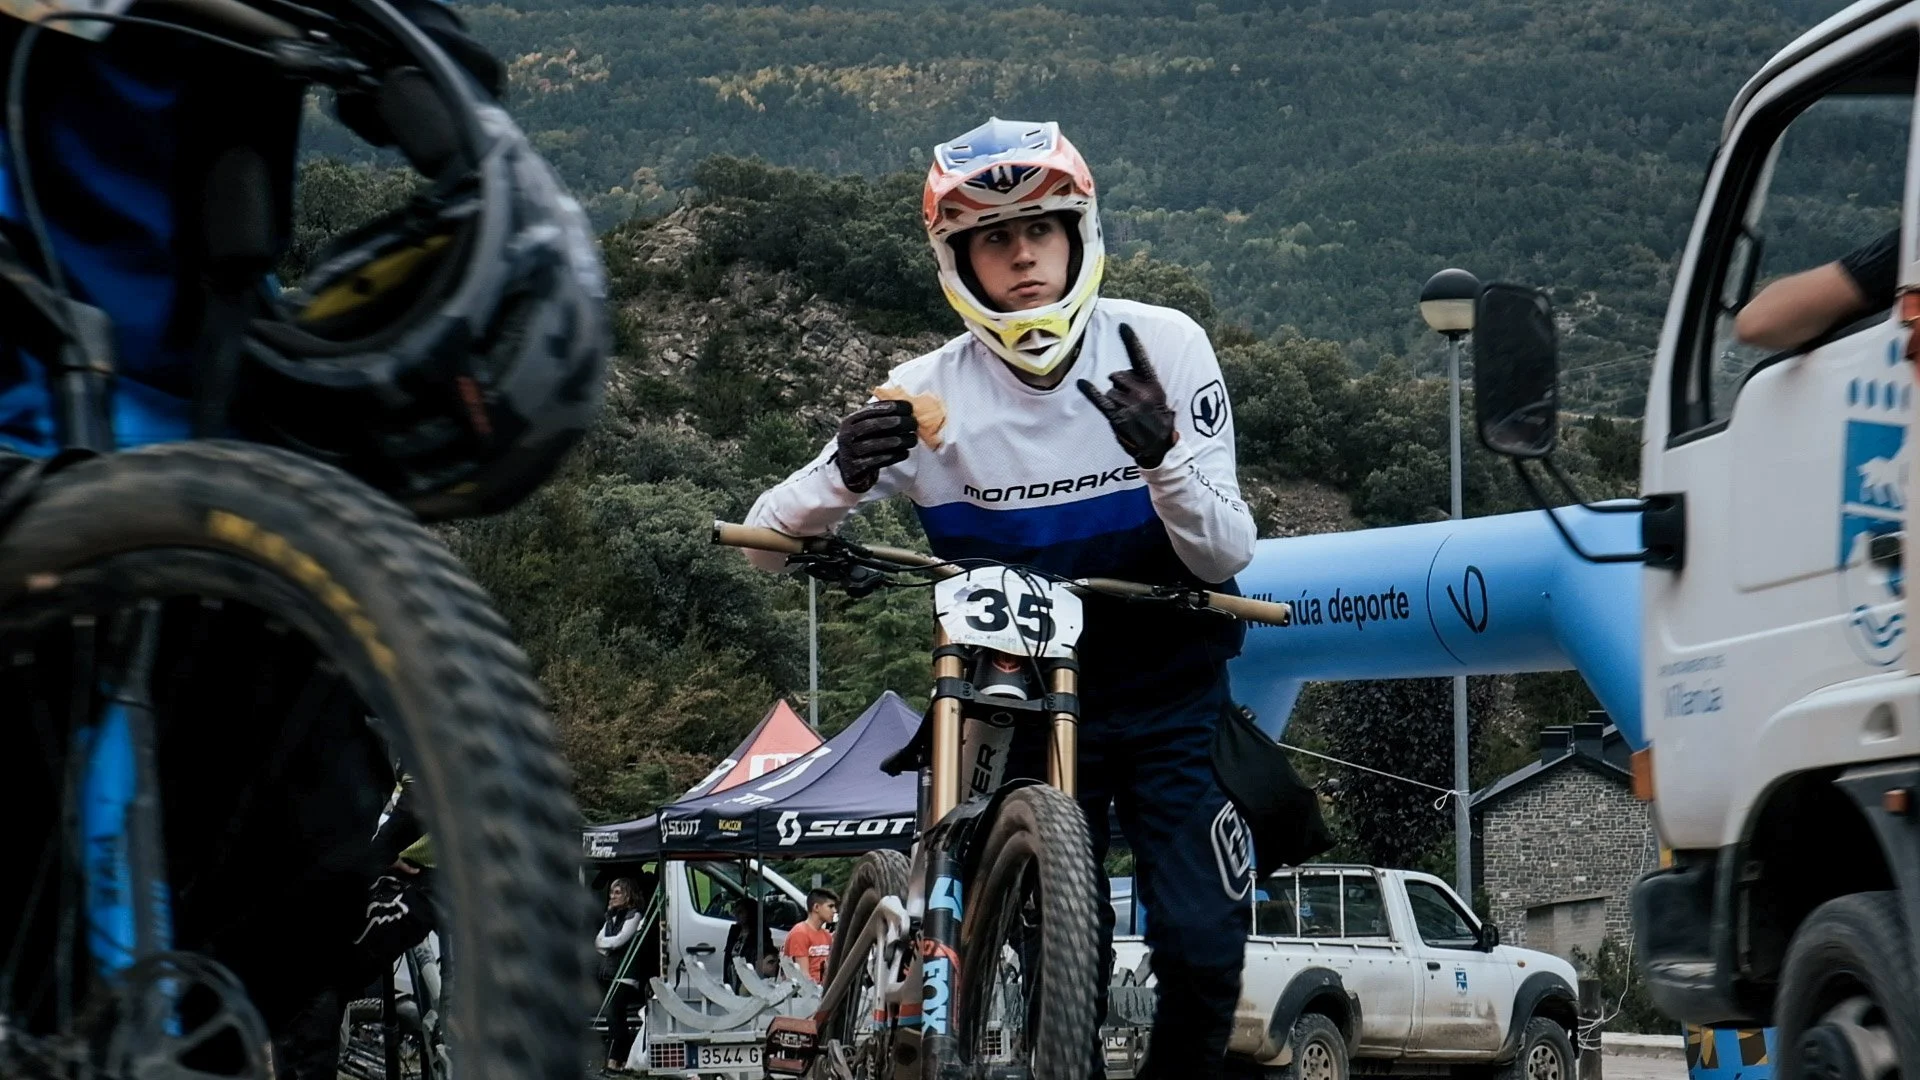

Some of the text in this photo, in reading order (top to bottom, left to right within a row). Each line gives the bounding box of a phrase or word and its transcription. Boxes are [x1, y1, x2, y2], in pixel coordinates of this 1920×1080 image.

[965, 588, 1057, 642] 35
[1328, 584, 1410, 631] deporte
[668, 819, 702, 836] SCOTT
[804, 817, 916, 837] SCOT
[921, 956, 950, 1039] FOX
[702, 1048, 744, 1065] 3544
